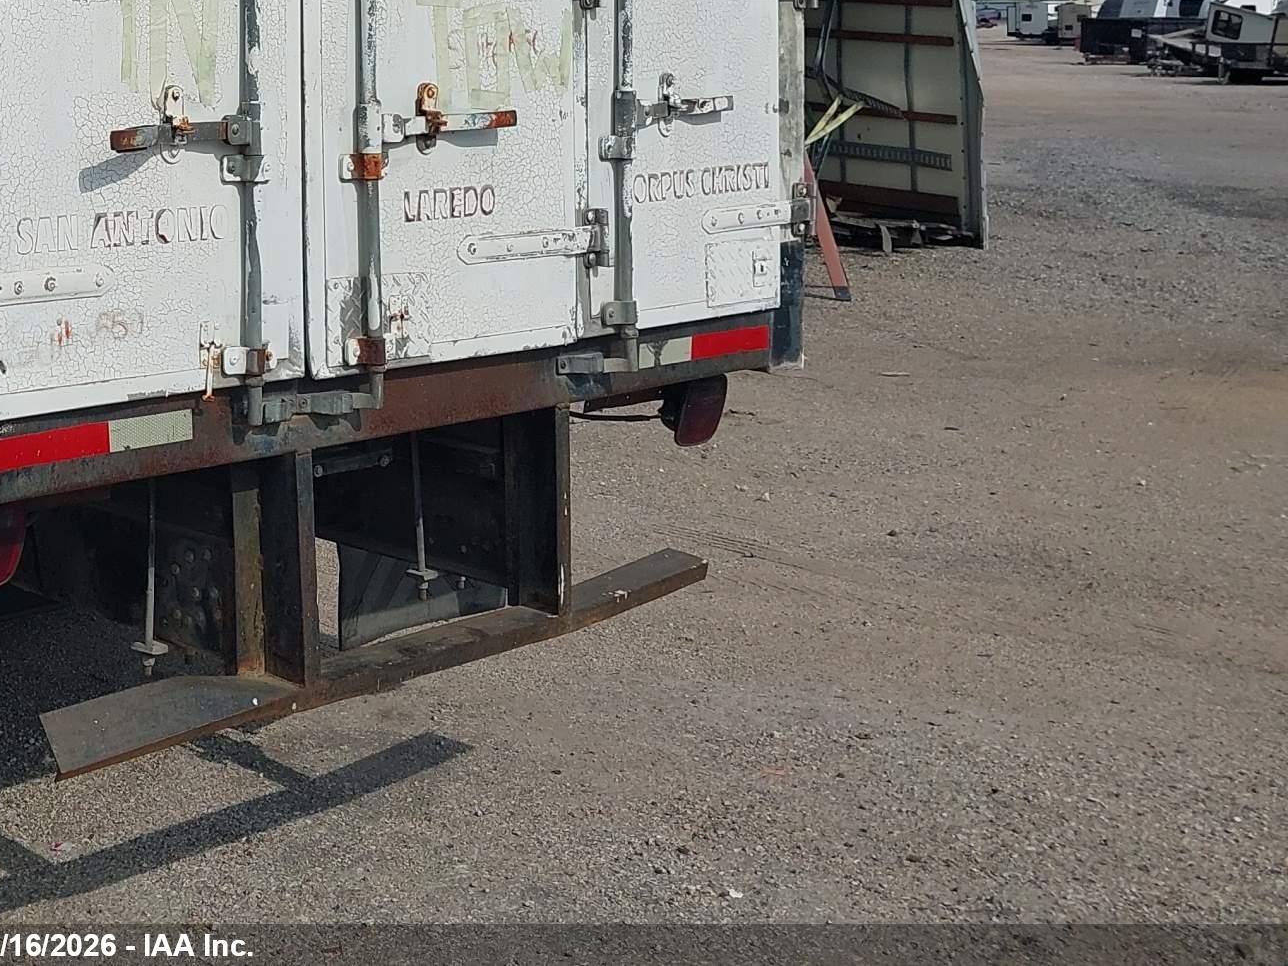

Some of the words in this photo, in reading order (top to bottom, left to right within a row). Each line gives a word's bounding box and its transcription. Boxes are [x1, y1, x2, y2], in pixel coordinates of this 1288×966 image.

[403, 184, 495, 222] LAREDO
[633, 170, 695, 204] ORPUS
[701, 162, 769, 196] CHRISTI
[16, 214, 78, 255] SAN
[91, 205, 229, 250] ANTONIO
